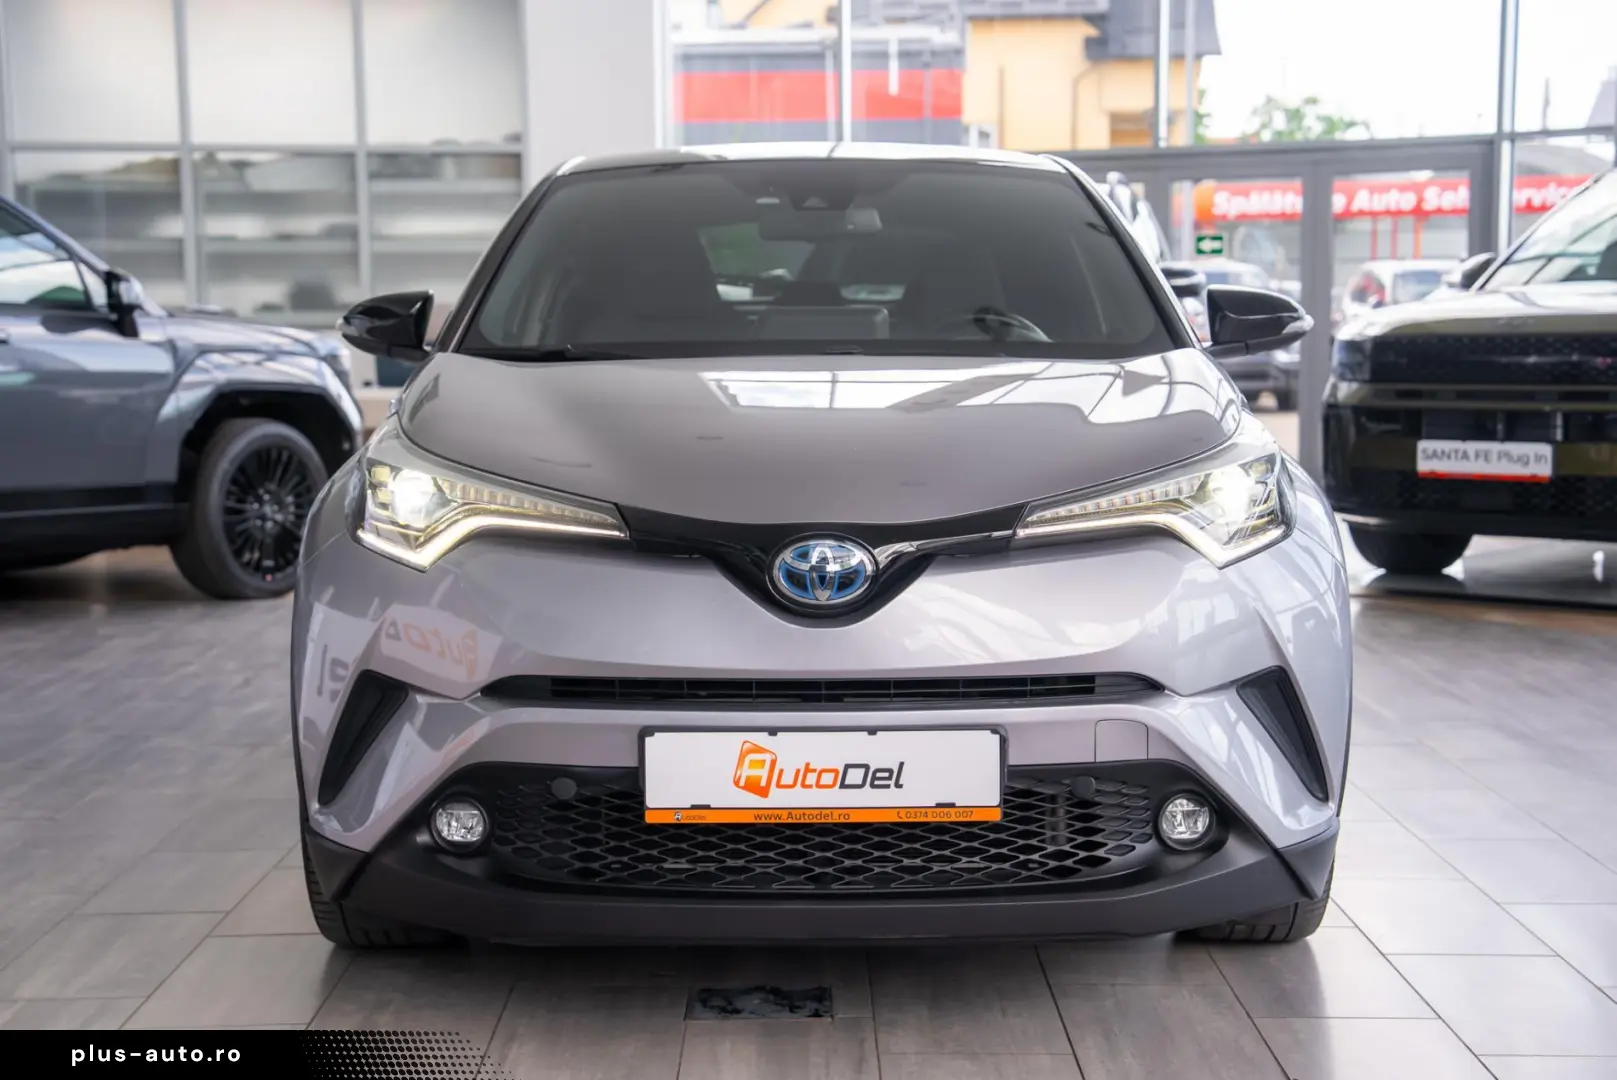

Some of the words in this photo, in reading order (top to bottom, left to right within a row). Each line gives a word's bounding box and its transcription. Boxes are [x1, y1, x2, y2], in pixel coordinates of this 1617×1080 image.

[1350, 187, 1418, 213] Auto
[1421, 184, 1470, 212] Sel
[1421, 447, 1470, 463] SANTA
[1475, 449, 1492, 463] FE
[1497, 450, 1530, 467] Plug
[1534, 452, 1549, 465] In
[733, 740, 904, 798] AutoDel
[753, 811, 850, 821] www.Autodel.ro
[905, 810, 929, 819] 0374
[932, 810, 952, 819] 006
[955, 810, 974, 819] 007
